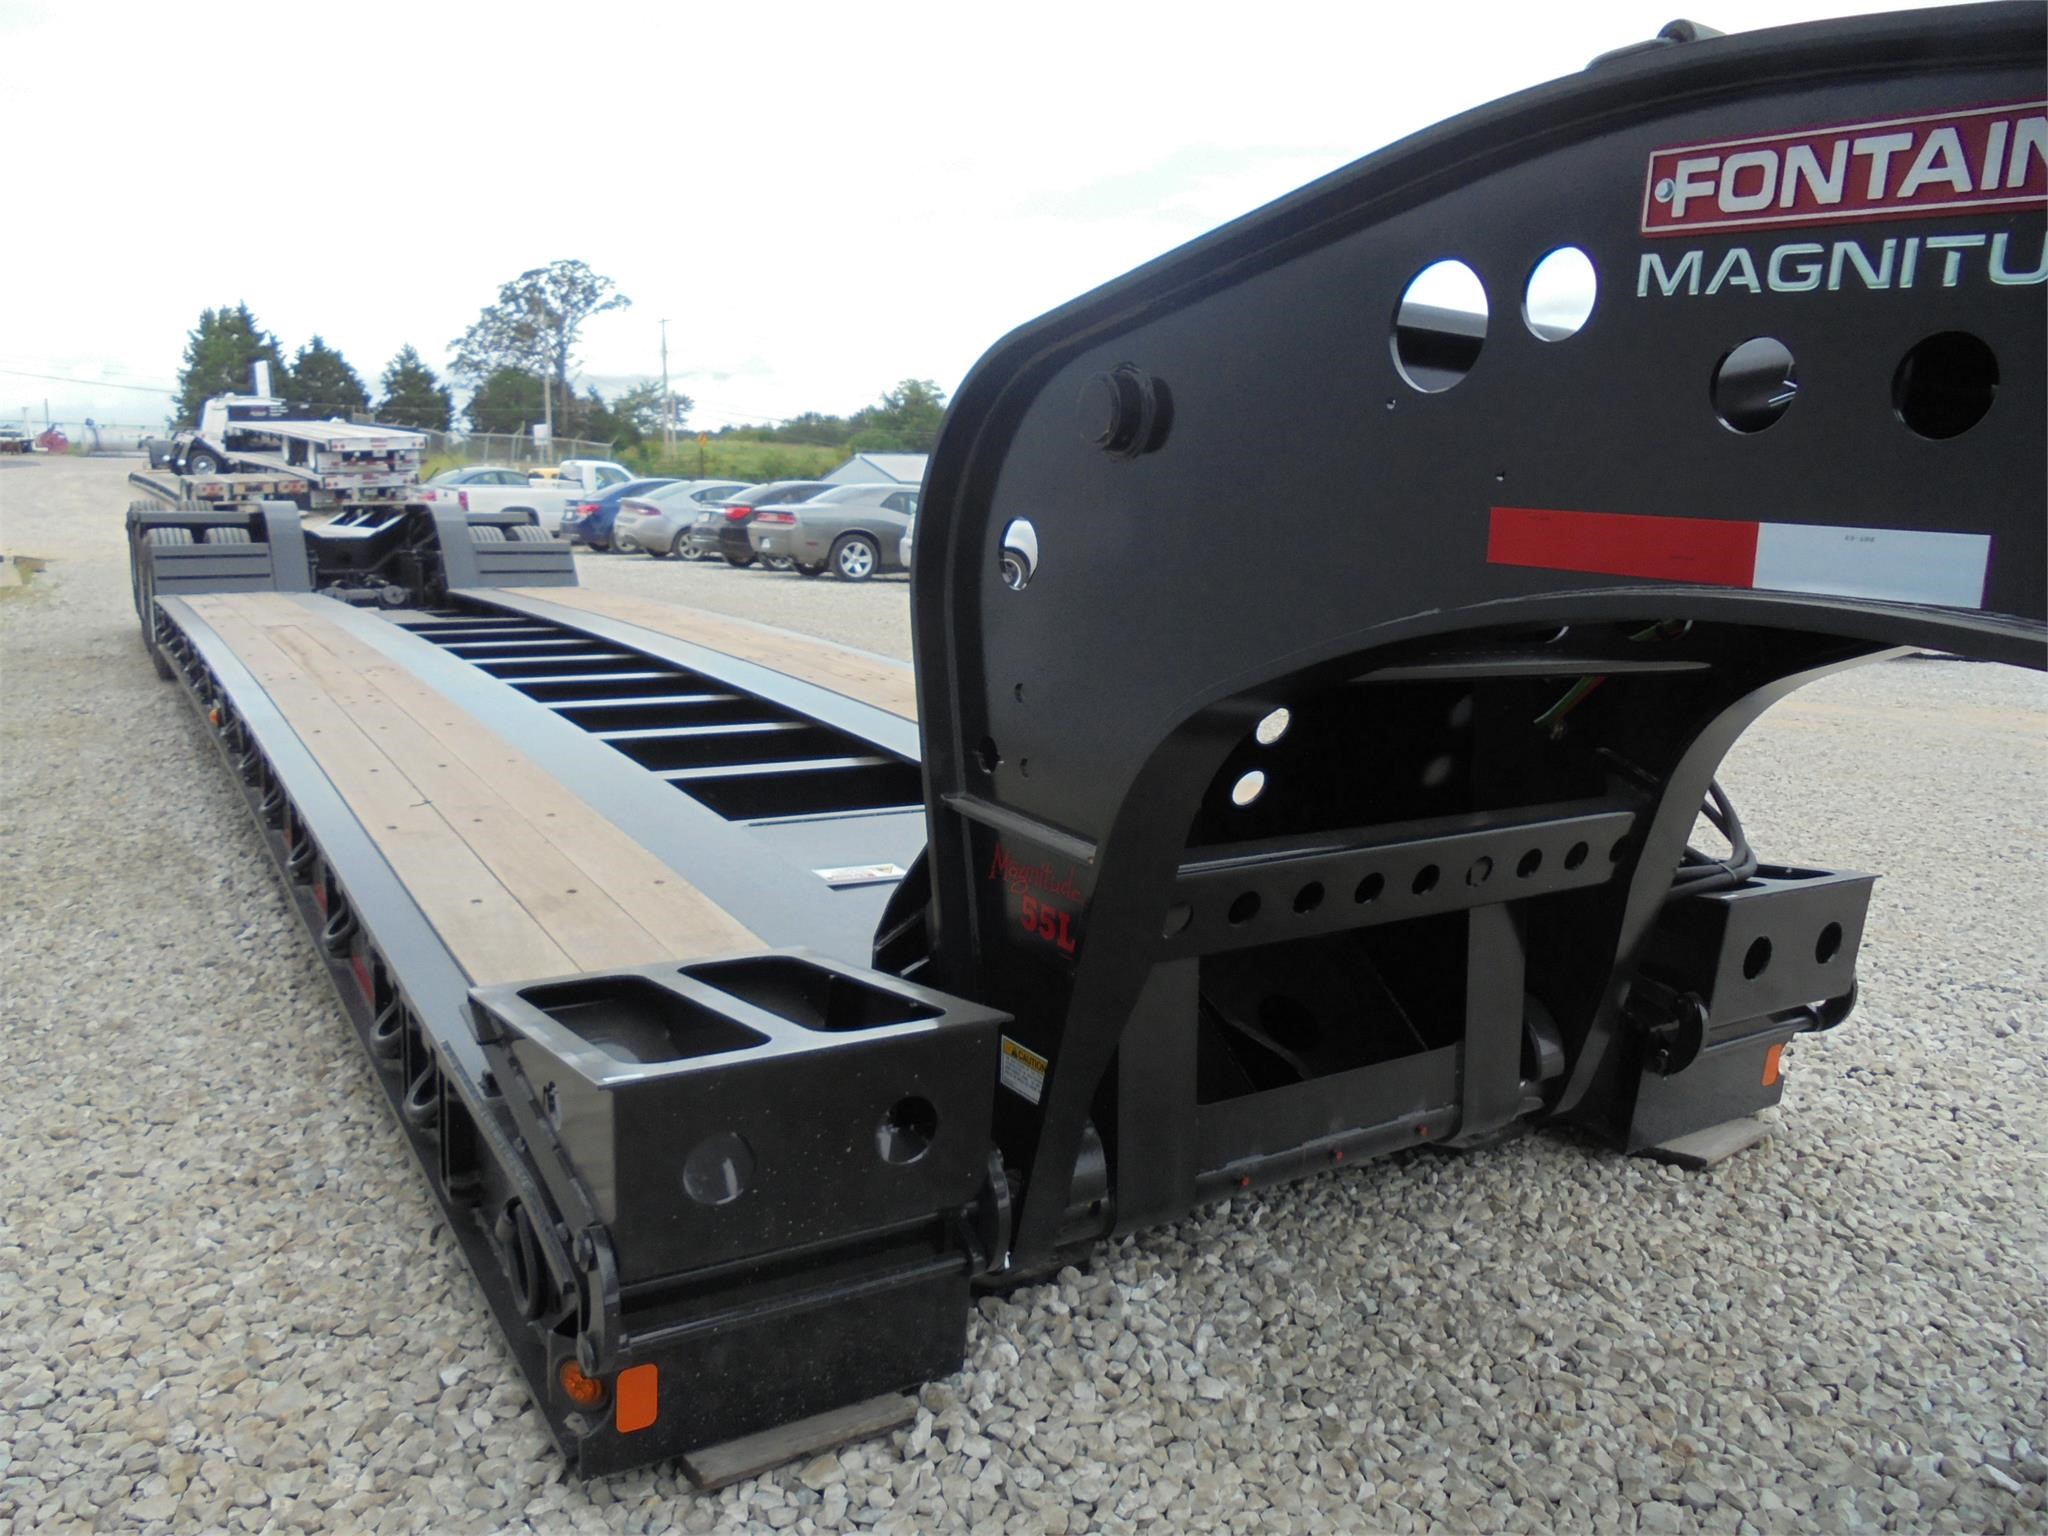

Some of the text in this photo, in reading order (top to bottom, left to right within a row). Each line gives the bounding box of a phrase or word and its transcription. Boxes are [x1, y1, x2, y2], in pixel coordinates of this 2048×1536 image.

[1637, 232, 2048, 297] MAGNITU
[1021, 895, 1077, 953] 55L
[1016, 1048, 1047, 1073] CAUTION
